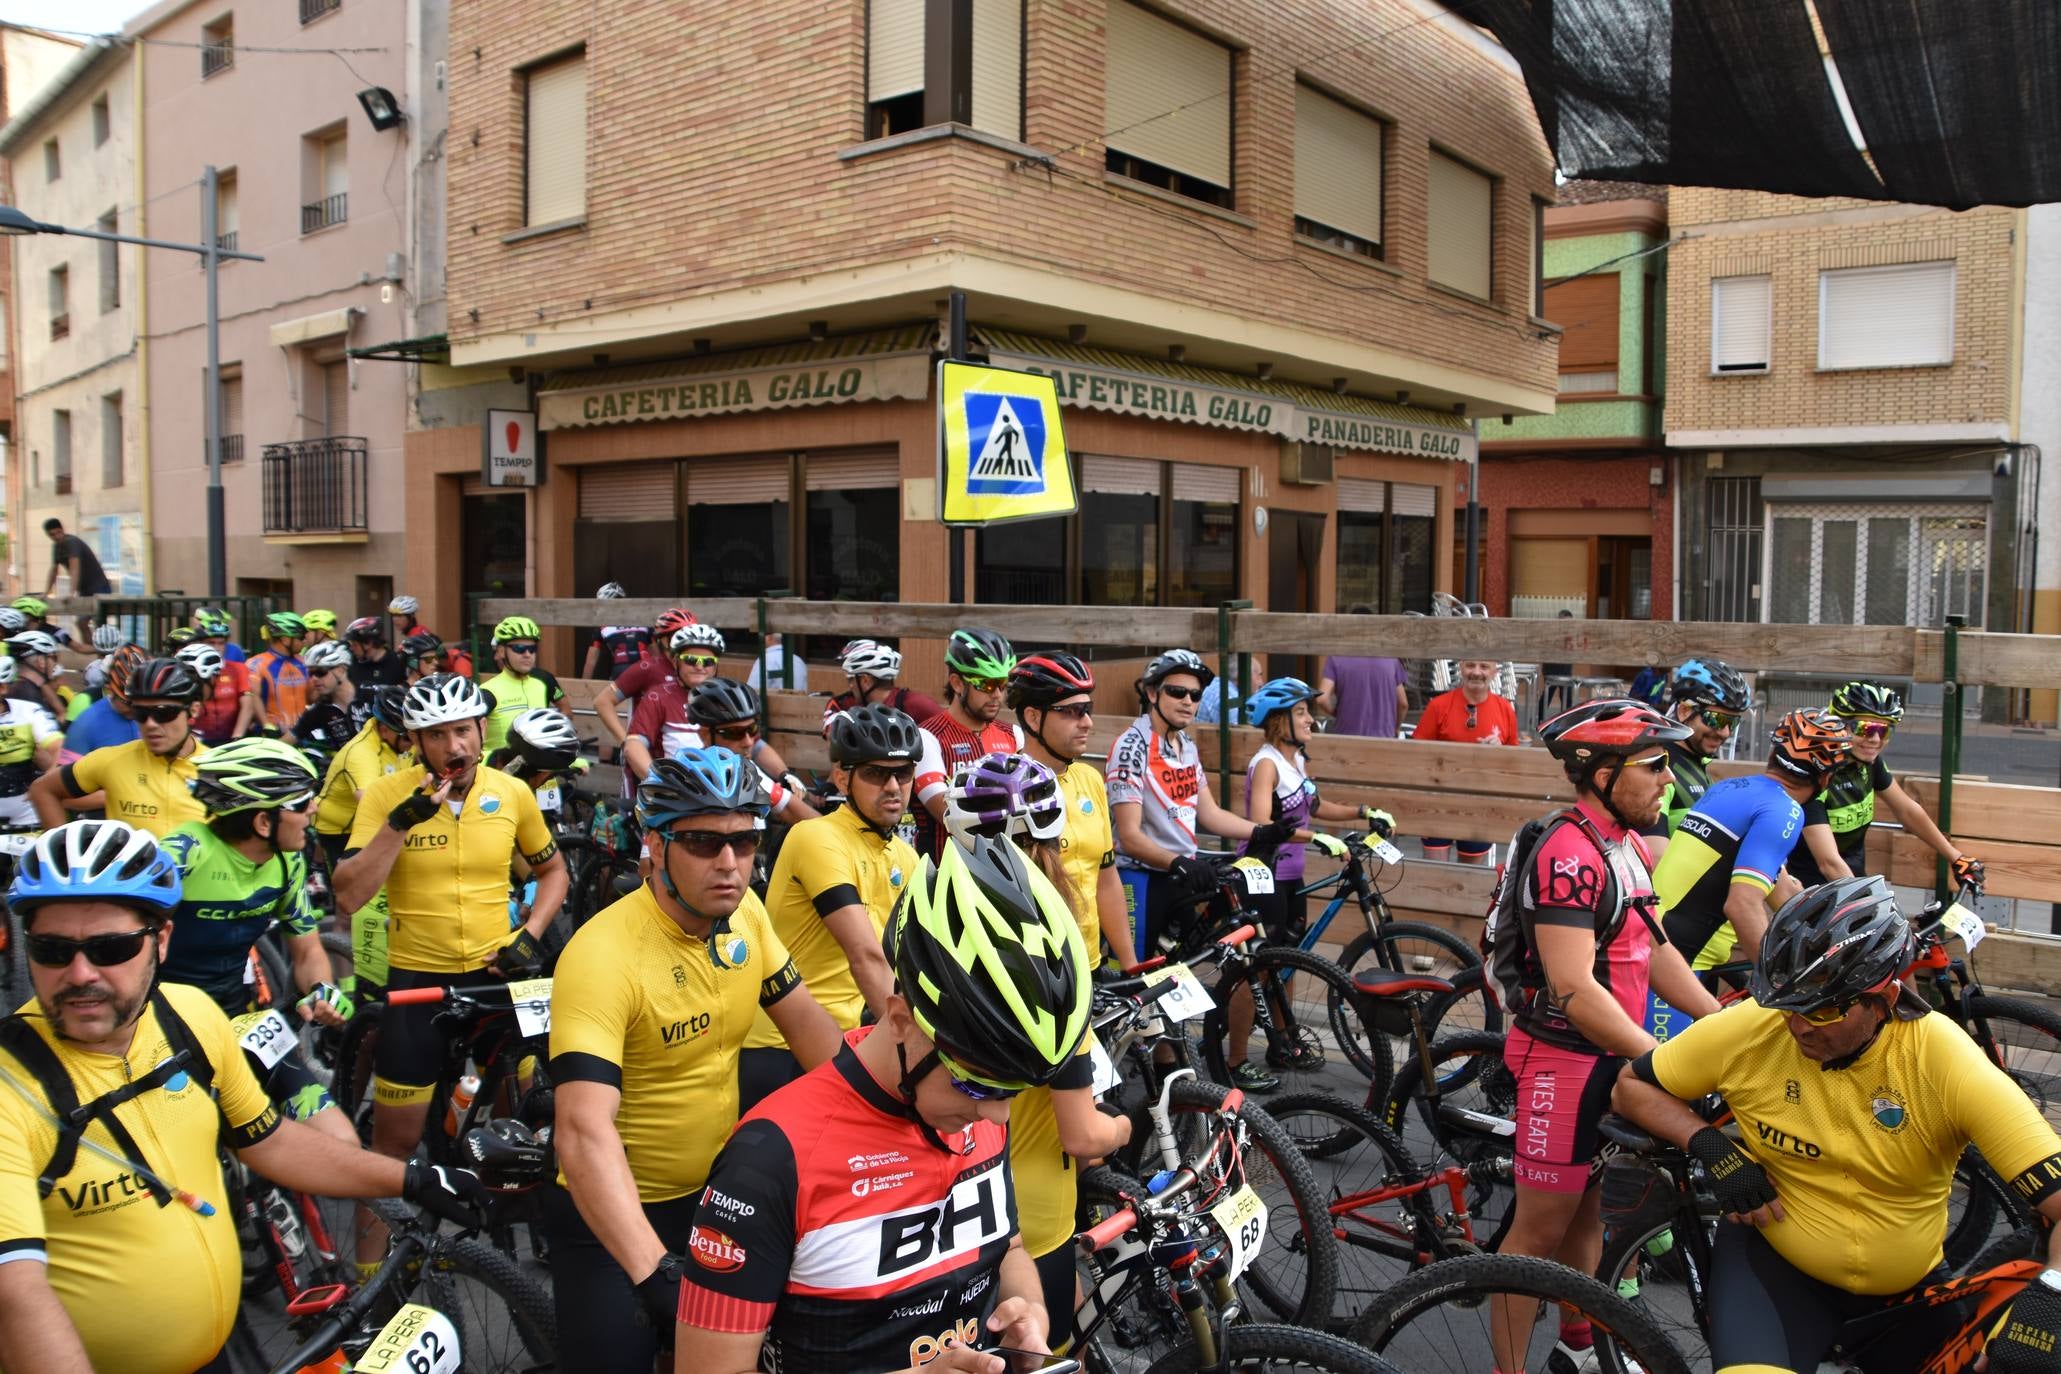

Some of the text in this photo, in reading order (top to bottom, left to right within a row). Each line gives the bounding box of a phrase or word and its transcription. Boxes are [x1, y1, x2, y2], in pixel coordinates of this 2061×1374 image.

[583, 367, 862, 420] CAFETERIA GALO
[1208, 395, 1273, 428] GALO
[1307, 415, 1461, 456] PANADERIA GALO
[493, 456, 533, 468] TEMPLO
[1171, 781, 1198, 801] LOPE
[119, 799, 159, 816] Virto
[404, 833, 448, 848] Virto
[1247, 868, 1270, 881] 195
[248, 1016, 284, 1050] 283
[661, 1012, 711, 1044] Virto
[1527, 1117, 1550, 1158] EATS
[1756, 1120, 1822, 1158] Virto
[866, 1151, 900, 1162] Gobierno
[869, 1155, 910, 1169] de La Rioja
[1528, 1170, 1560, 1185] EATS
[73, 1197, 141, 1218] ultracongelados
[711, 1190, 755, 1217] TEMPLO
[877, 1178, 998, 1278] BH
[1241, 1217, 1259, 1252] 68
[690, 1226, 746, 1263] Benis
[700, 1253, 717, 1264] food
[888, 1289, 949, 1320] Nocedal
[960, 1276, 990, 1306] HUEDA
[368, 1309, 428, 1370] LA PERA
[406, 1331, 446, 1374] 62
